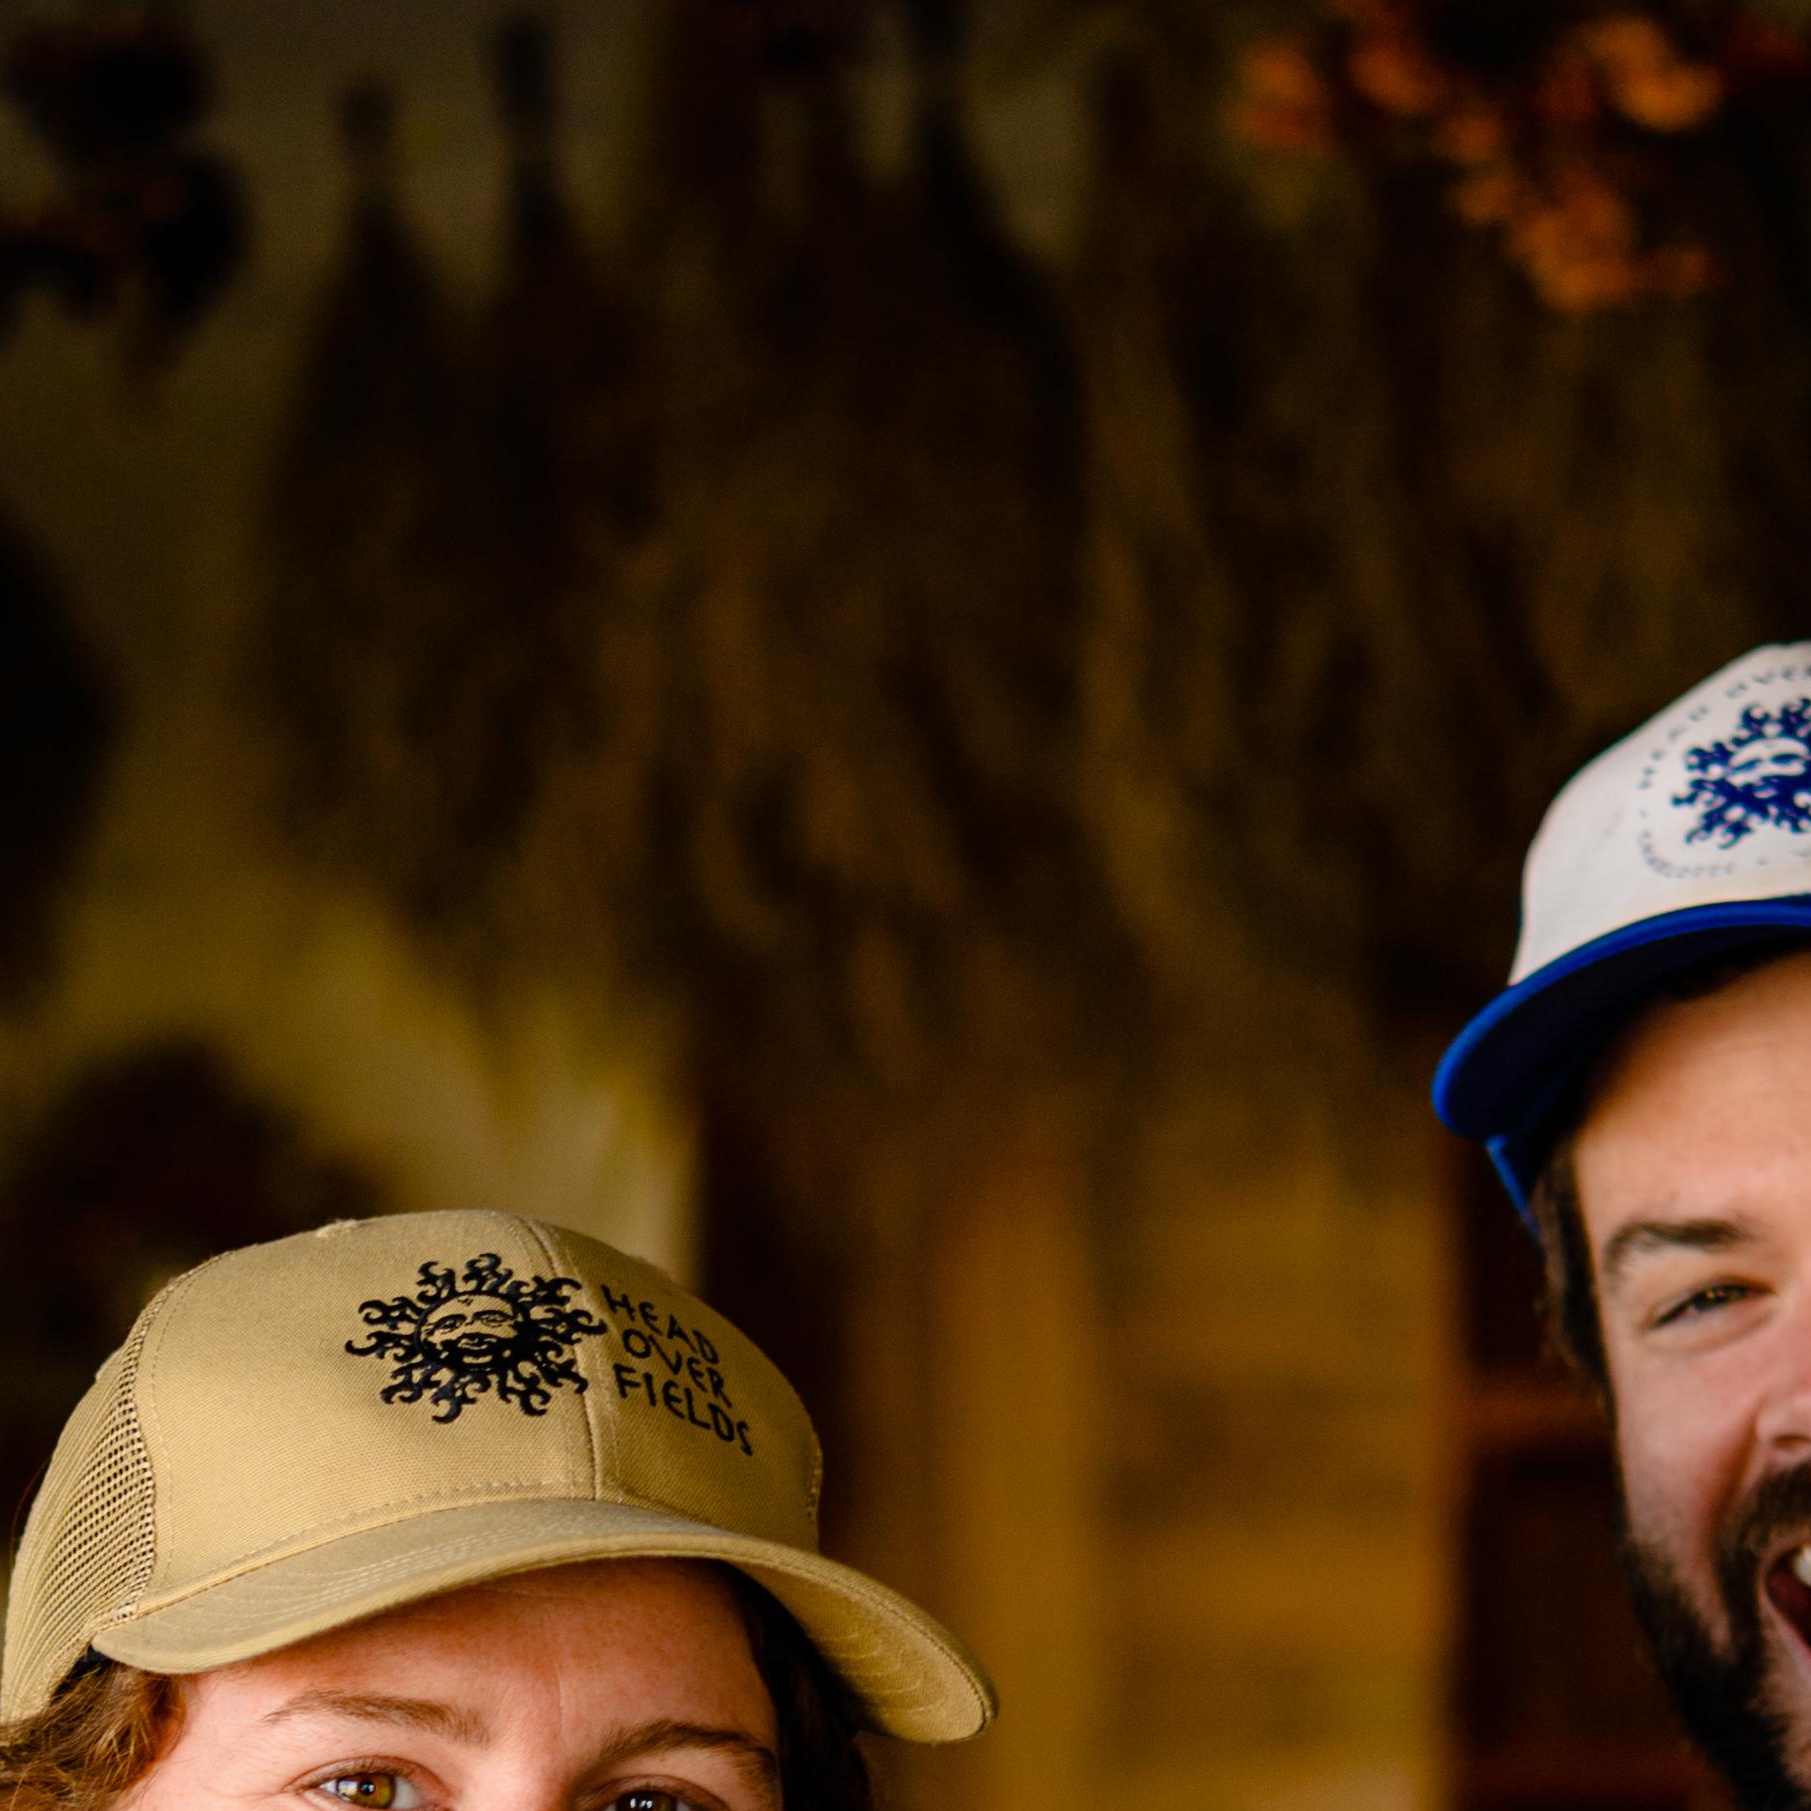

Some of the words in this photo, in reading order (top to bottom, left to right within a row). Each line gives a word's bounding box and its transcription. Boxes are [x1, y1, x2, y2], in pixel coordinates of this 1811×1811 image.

[600, 1284, 719, 1365] HEAD
[622, 1328, 732, 1408] OVER
[613, 1363, 753, 1456] FIELDS
